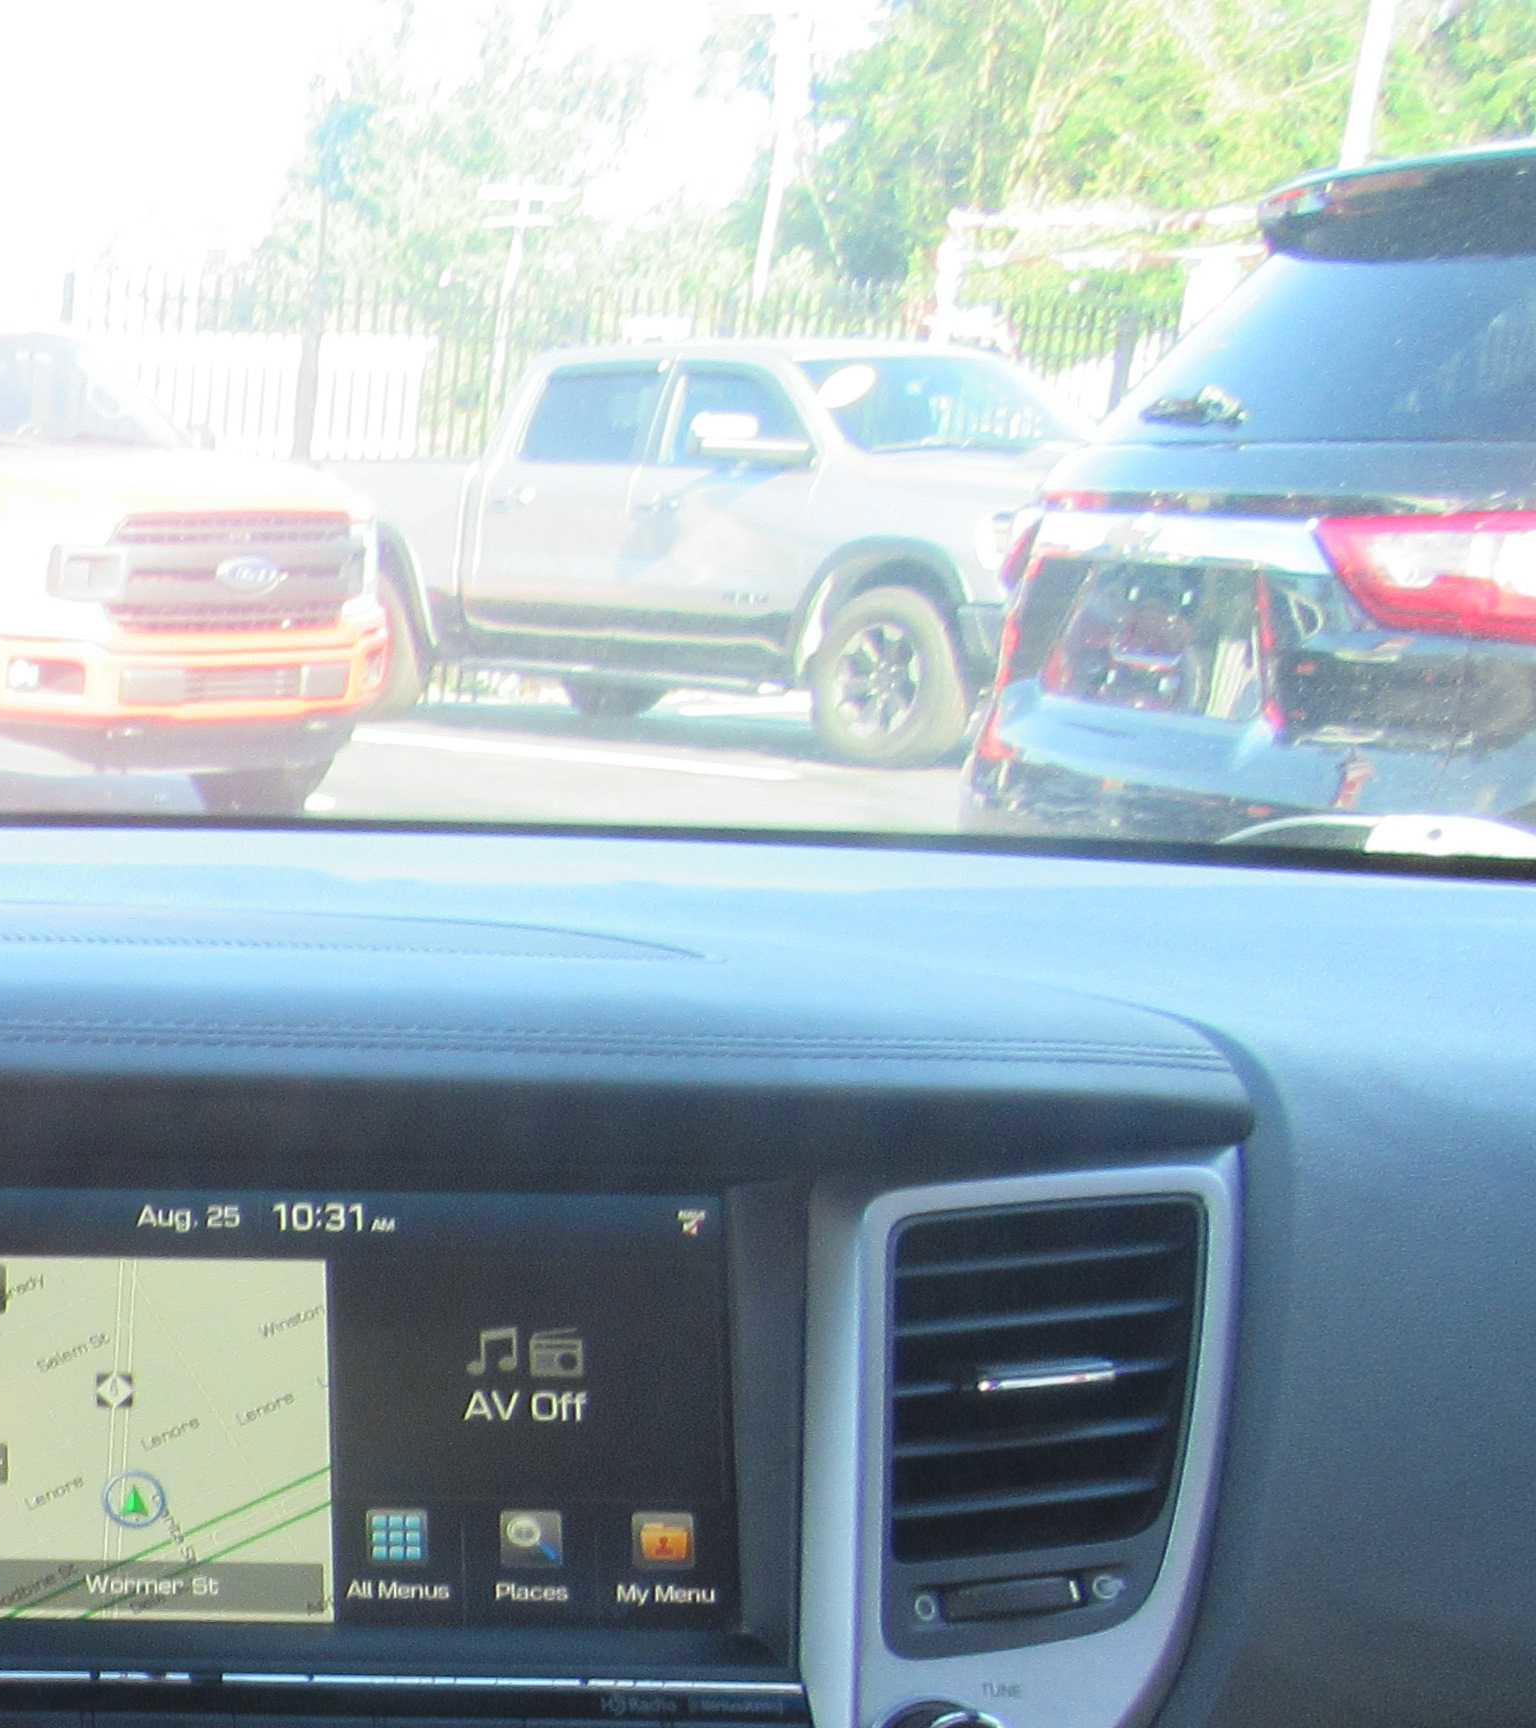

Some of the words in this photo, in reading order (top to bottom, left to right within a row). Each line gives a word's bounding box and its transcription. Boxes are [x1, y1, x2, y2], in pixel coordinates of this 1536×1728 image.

[206, 1205, 241, 1228] 25
[271, 1202, 365, 1232] 10:31
[371, 1218, 396, 1234] AM
[463, 1390, 520, 1422] AV
[530, 1390, 589, 1423] Off
[84, 1573, 183, 1598] Wormer
[191, 1575, 219, 1597] St
[346, 1578, 373, 1600] All
[378, 1580, 450, 1601] Menus
[494, 1581, 569, 1602] Places
[616, 1584, 647, 1607] My
[654, 1584, 716, 1604] Menu
